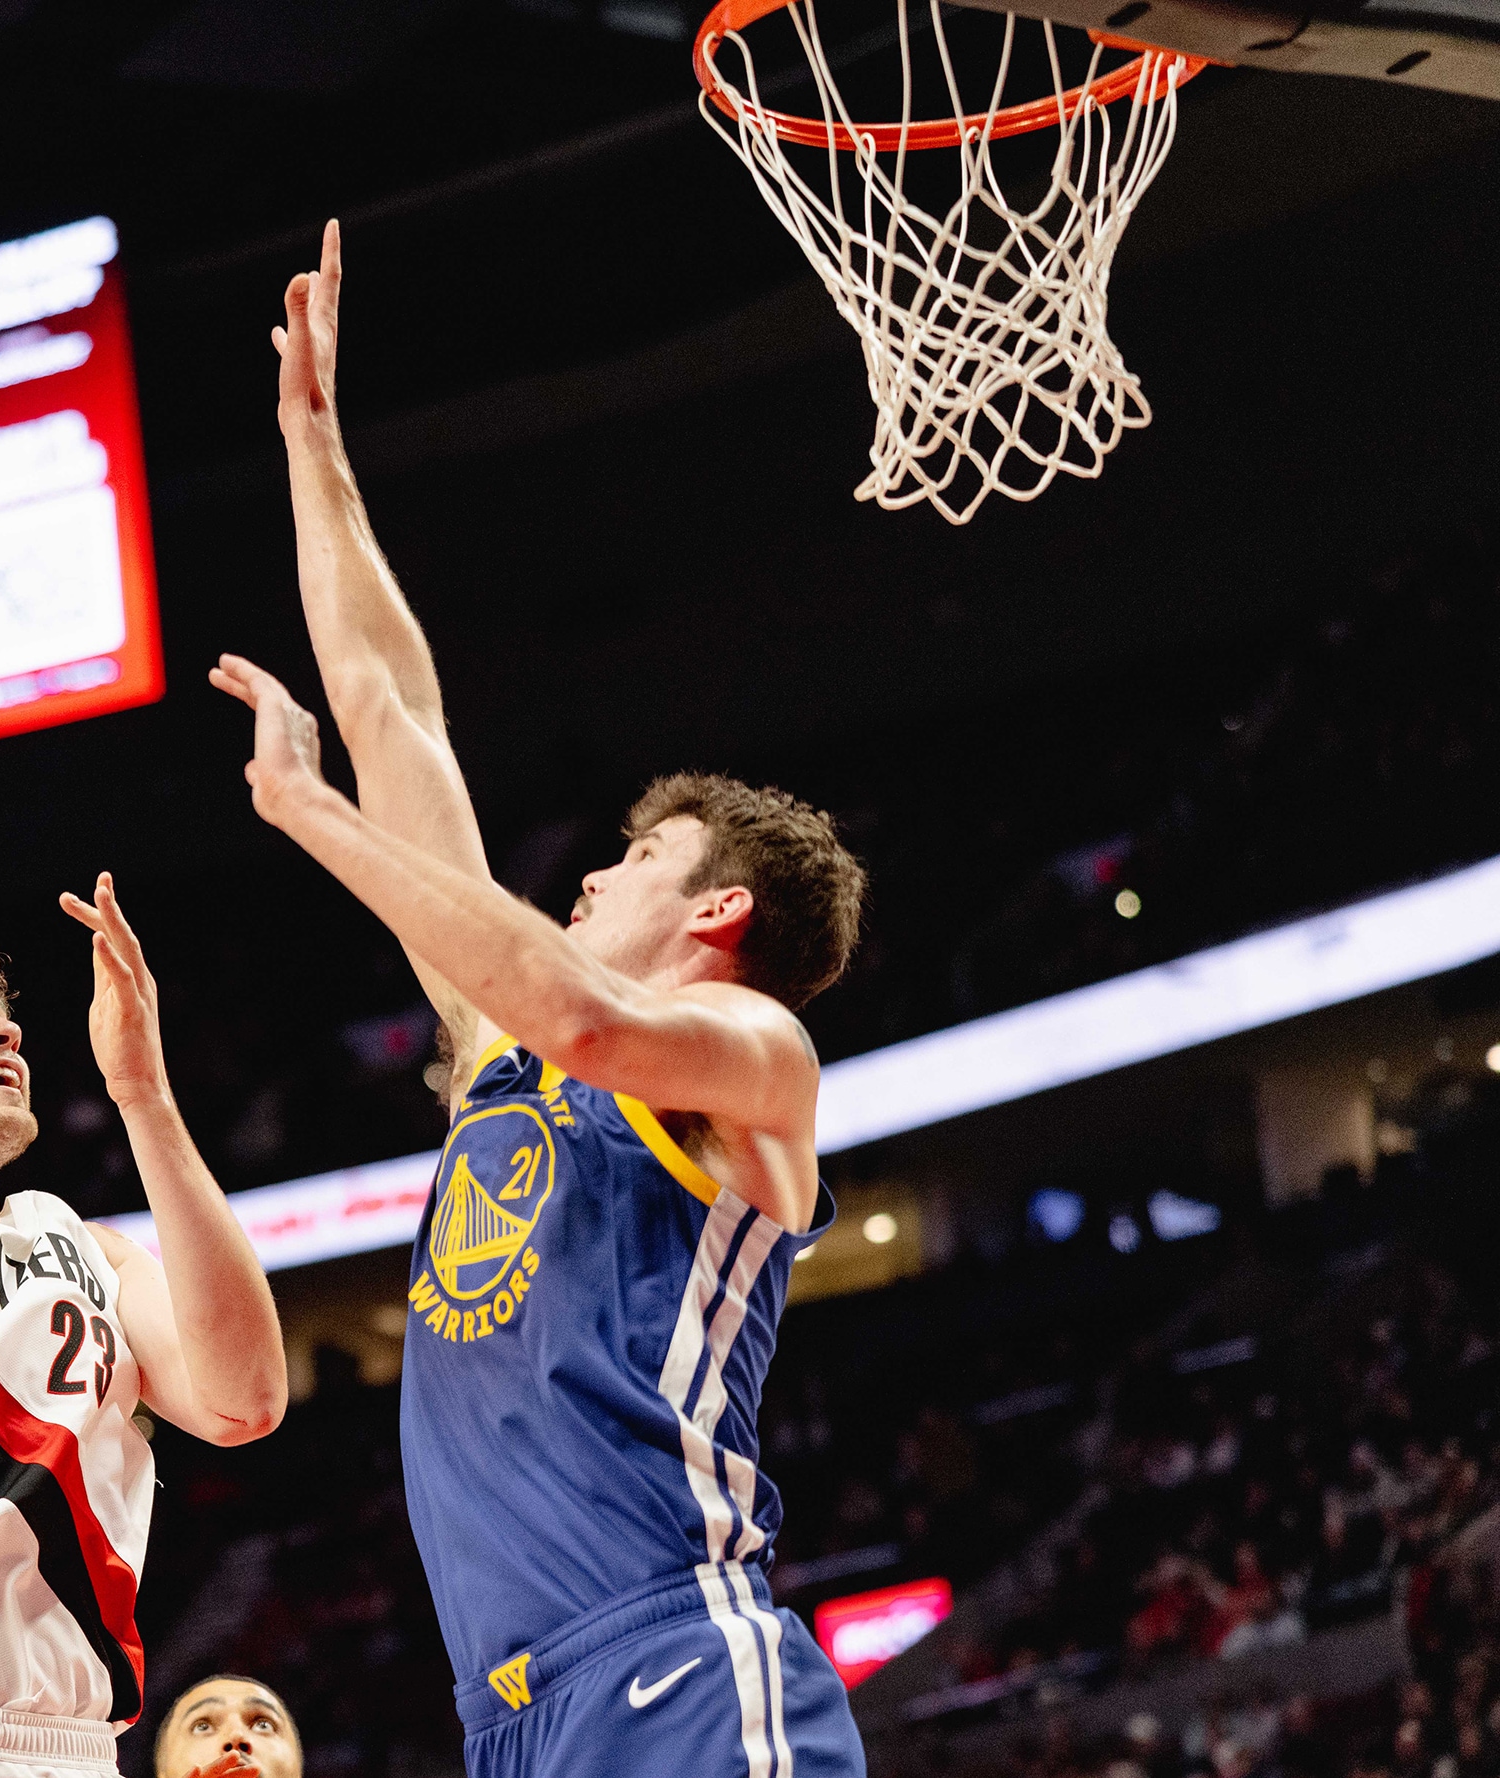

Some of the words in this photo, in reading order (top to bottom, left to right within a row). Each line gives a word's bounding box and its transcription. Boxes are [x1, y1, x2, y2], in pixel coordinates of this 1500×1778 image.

[498, 1143, 543, 1200] 21
[408, 1246, 540, 1343] WARRIORS
[47, 1299, 116, 1409] 23
